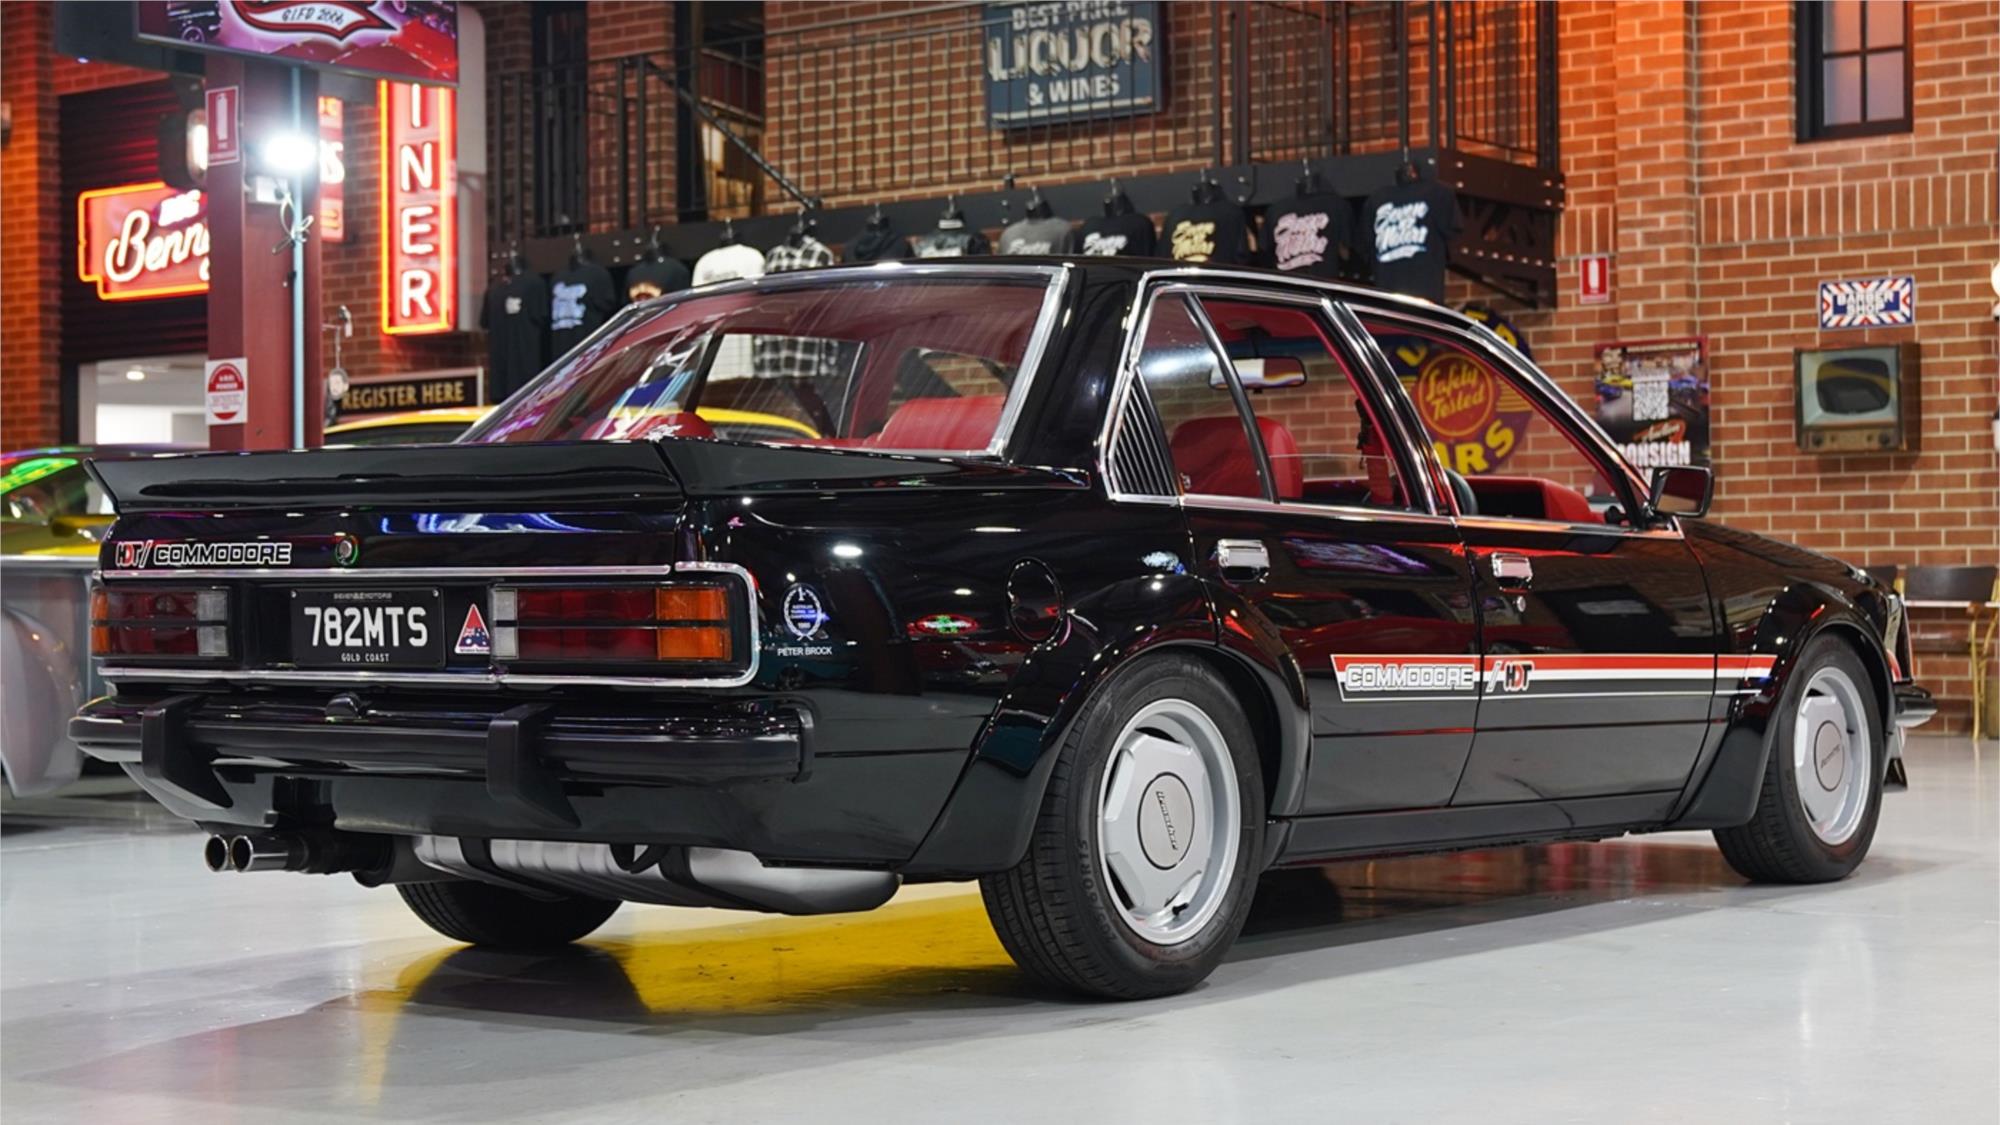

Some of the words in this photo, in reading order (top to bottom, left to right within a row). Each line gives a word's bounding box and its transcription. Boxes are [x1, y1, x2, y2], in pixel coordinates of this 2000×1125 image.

[1012, 5, 1061, 31] BEST
[988, 18, 1152, 81] LIQUOR
[1029, 83, 1043, 106] &
[1050, 73, 1120, 103] WINES
[401, 84, 434, 317] INER
[105, 209, 210, 283] Benn
[1837, 289, 1894, 306] BARBER
[1847, 301, 1885, 317] SHOP
[341, 384, 417, 409] REGISTER
[421, 380, 465, 404] HERE
[1426, 362, 1479, 401] Safety
[1431, 384, 1485, 421] Tested
[1432, 419, 1514, 476] ARS
[154, 543, 292, 565] COMMODORE
[304, 606, 428, 647] 782MTS
[341, 653, 361, 662] GOLD
[364, 653, 390, 662] COAST
[777, 647, 804, 657] PETER
[805, 646, 833, 656] BROCK
[1345, 664, 1475, 690] COMMODORE
